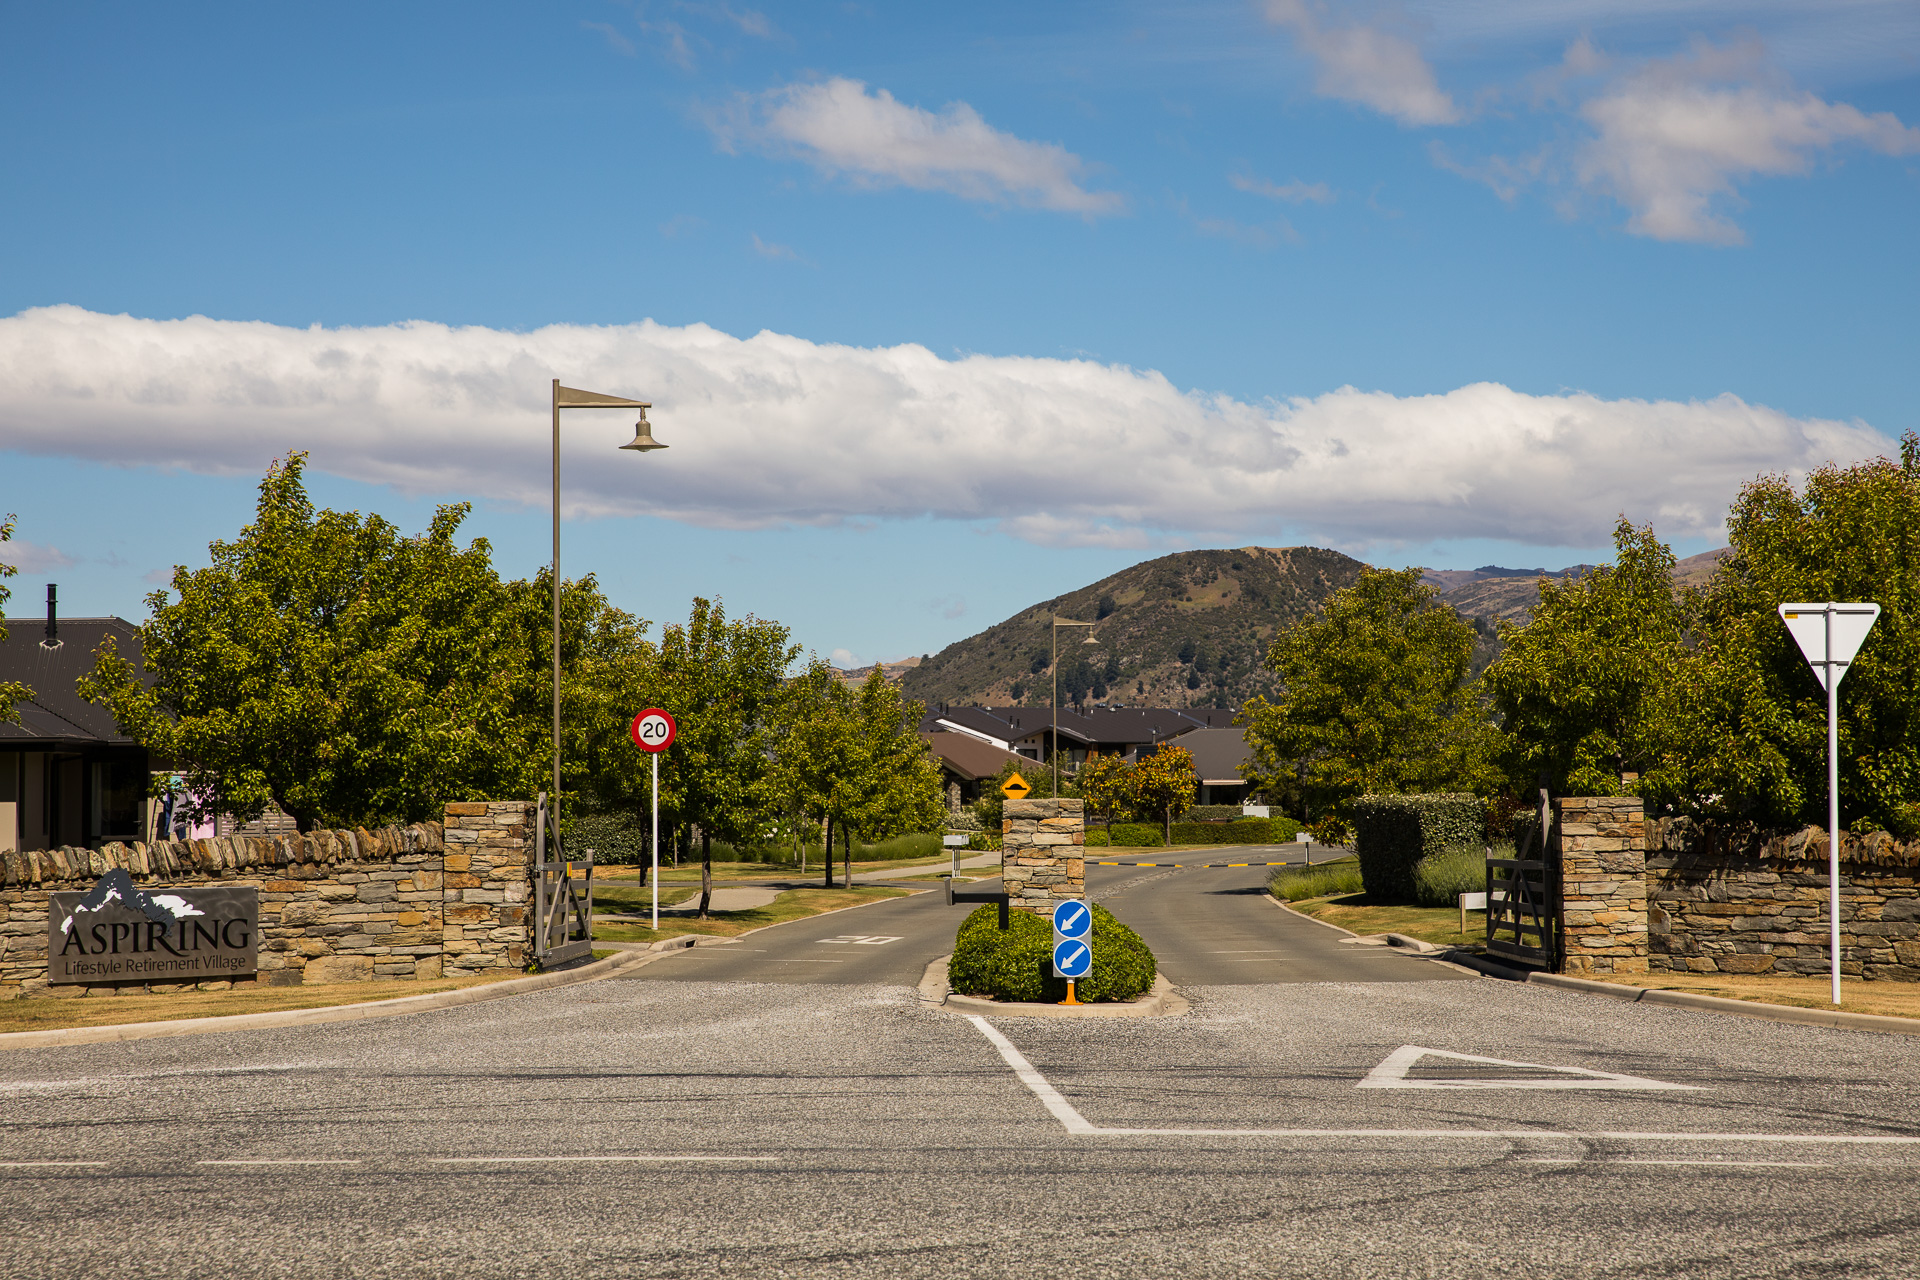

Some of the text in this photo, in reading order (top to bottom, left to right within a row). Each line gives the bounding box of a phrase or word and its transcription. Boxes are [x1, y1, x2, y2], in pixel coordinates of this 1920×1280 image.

[643, 722, 666, 738] 20
[58, 918, 250, 957] ASPIRING
[815, 935, 905, 945] 20
[65, 955, 246, 977] Lifestyle Retirement Village
